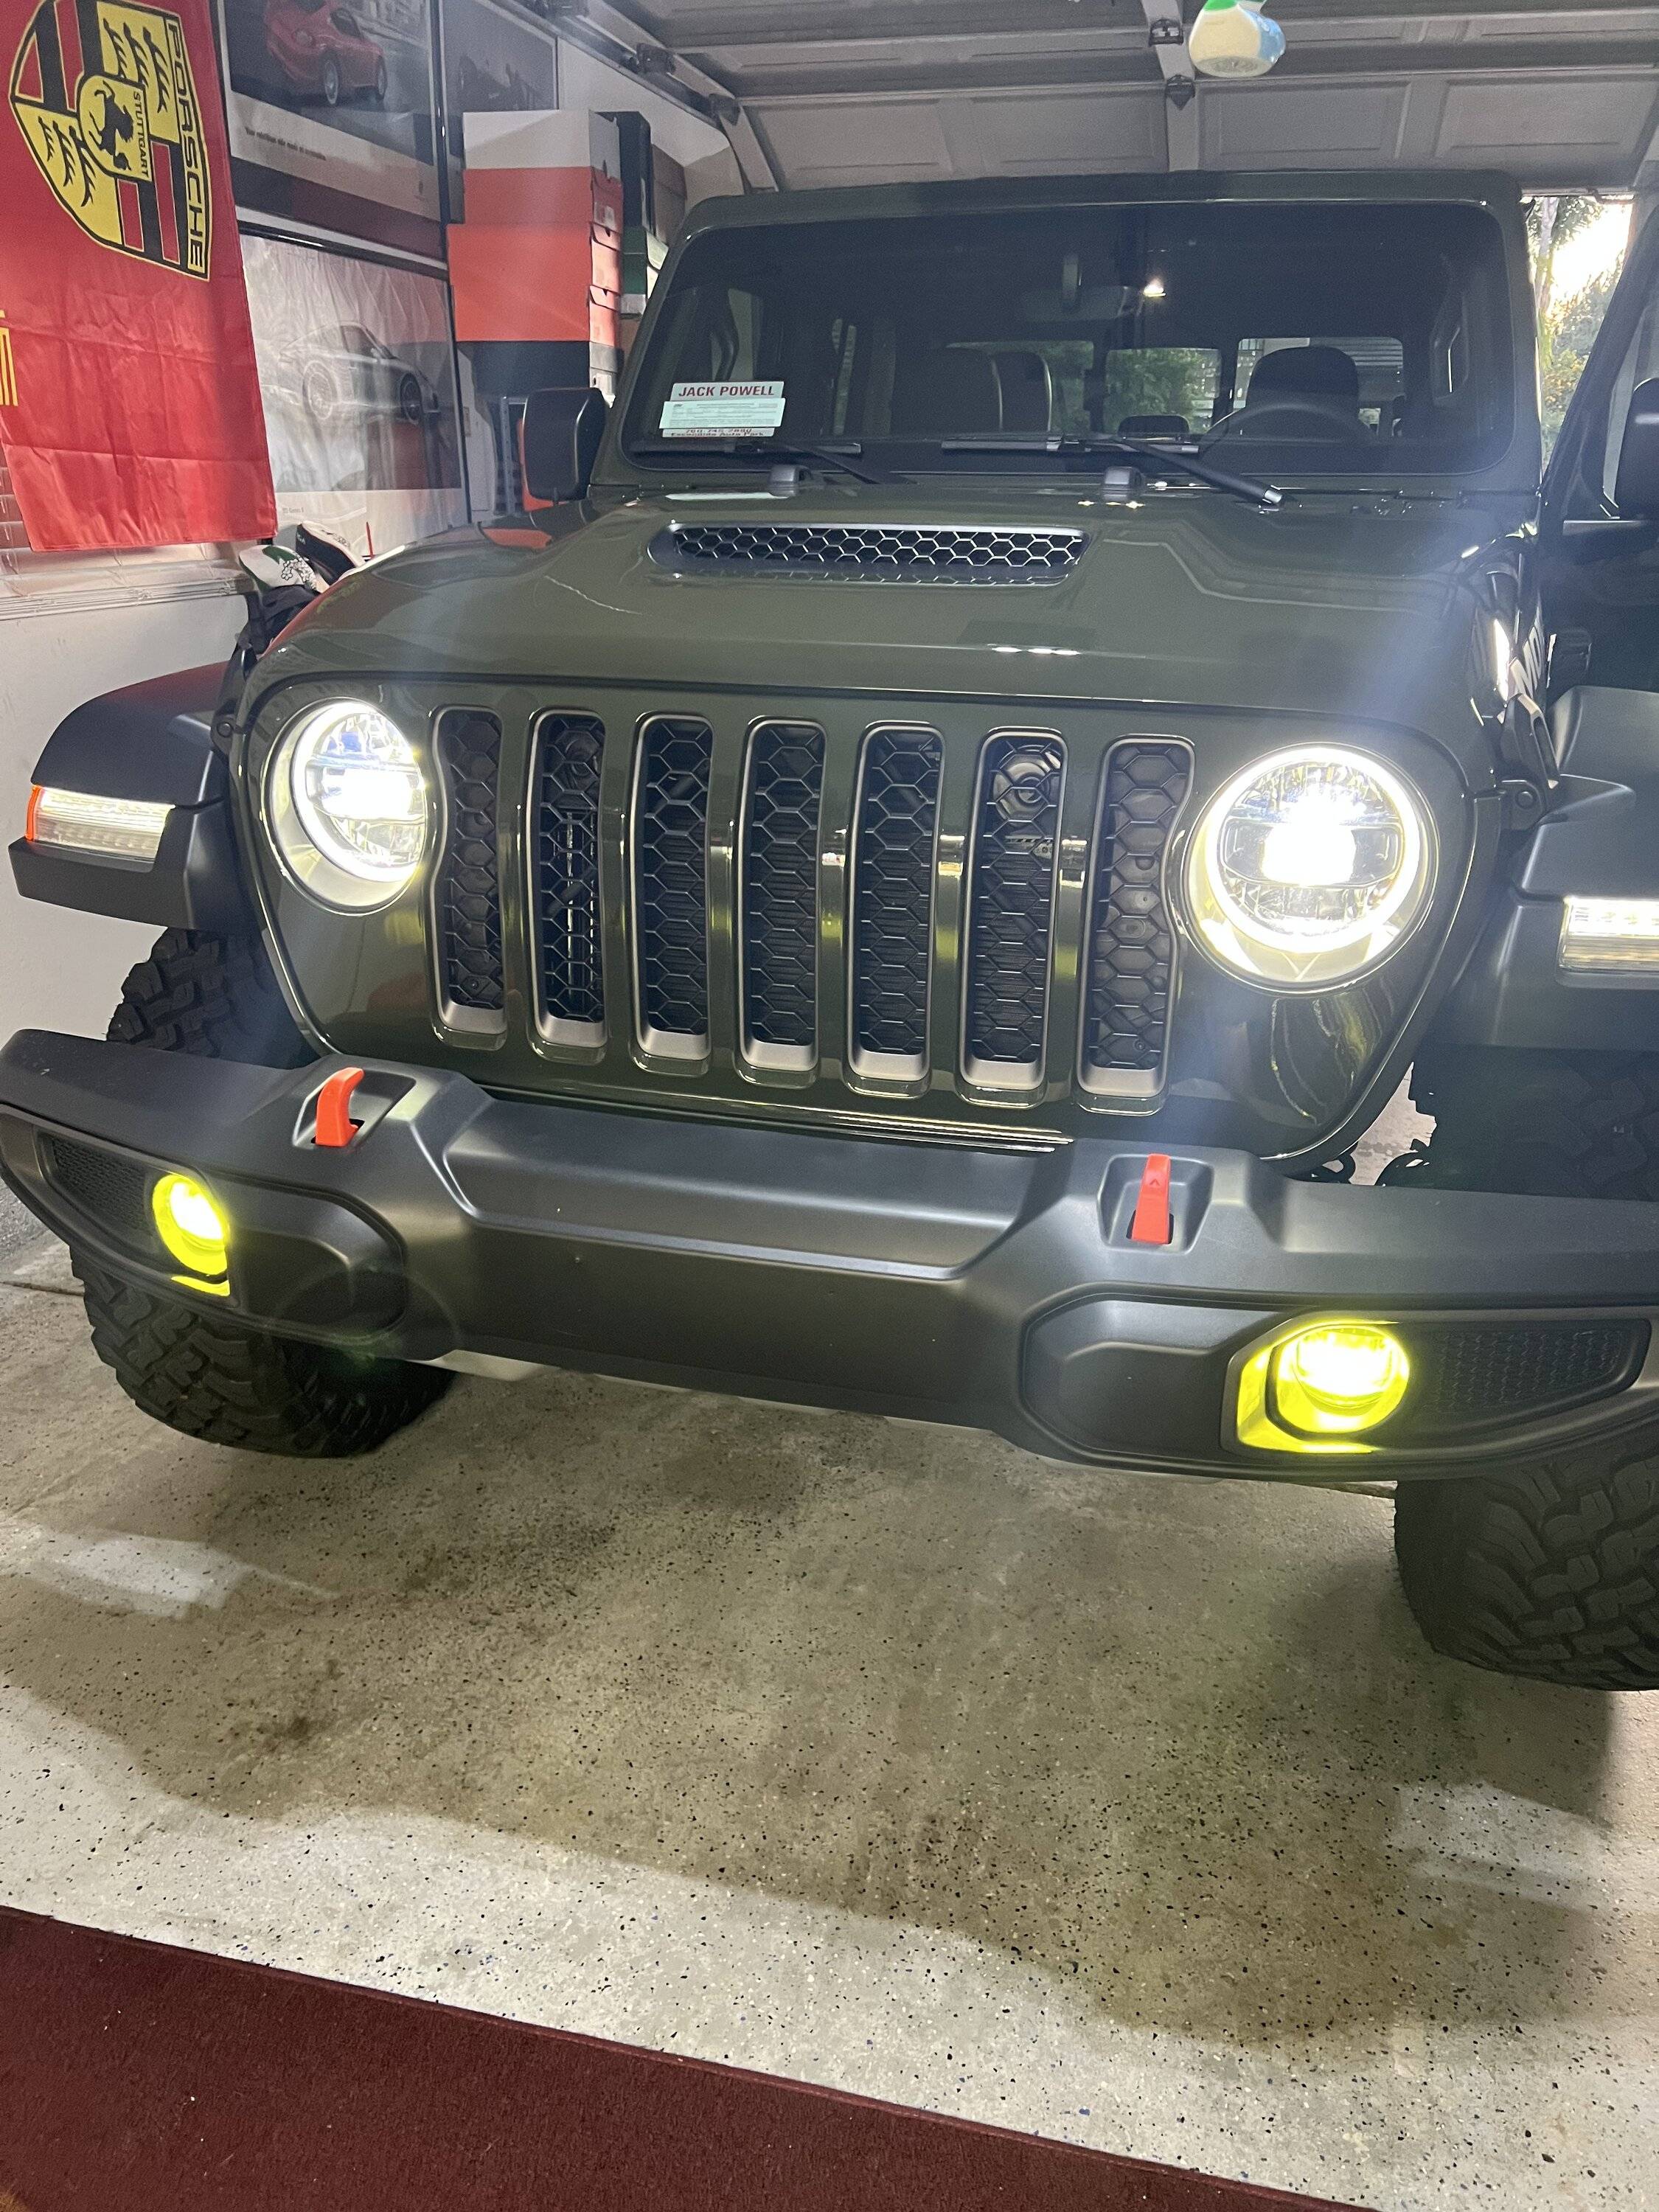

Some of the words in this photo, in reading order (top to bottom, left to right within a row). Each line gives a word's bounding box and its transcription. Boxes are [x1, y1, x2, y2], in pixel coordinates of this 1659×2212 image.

[133, 90, 150, 176] STUTTGART
[168, 24, 204, 268] PORSCHE
[678, 386, 714, 397] JACK
[720, 386, 775, 396] POWELL
